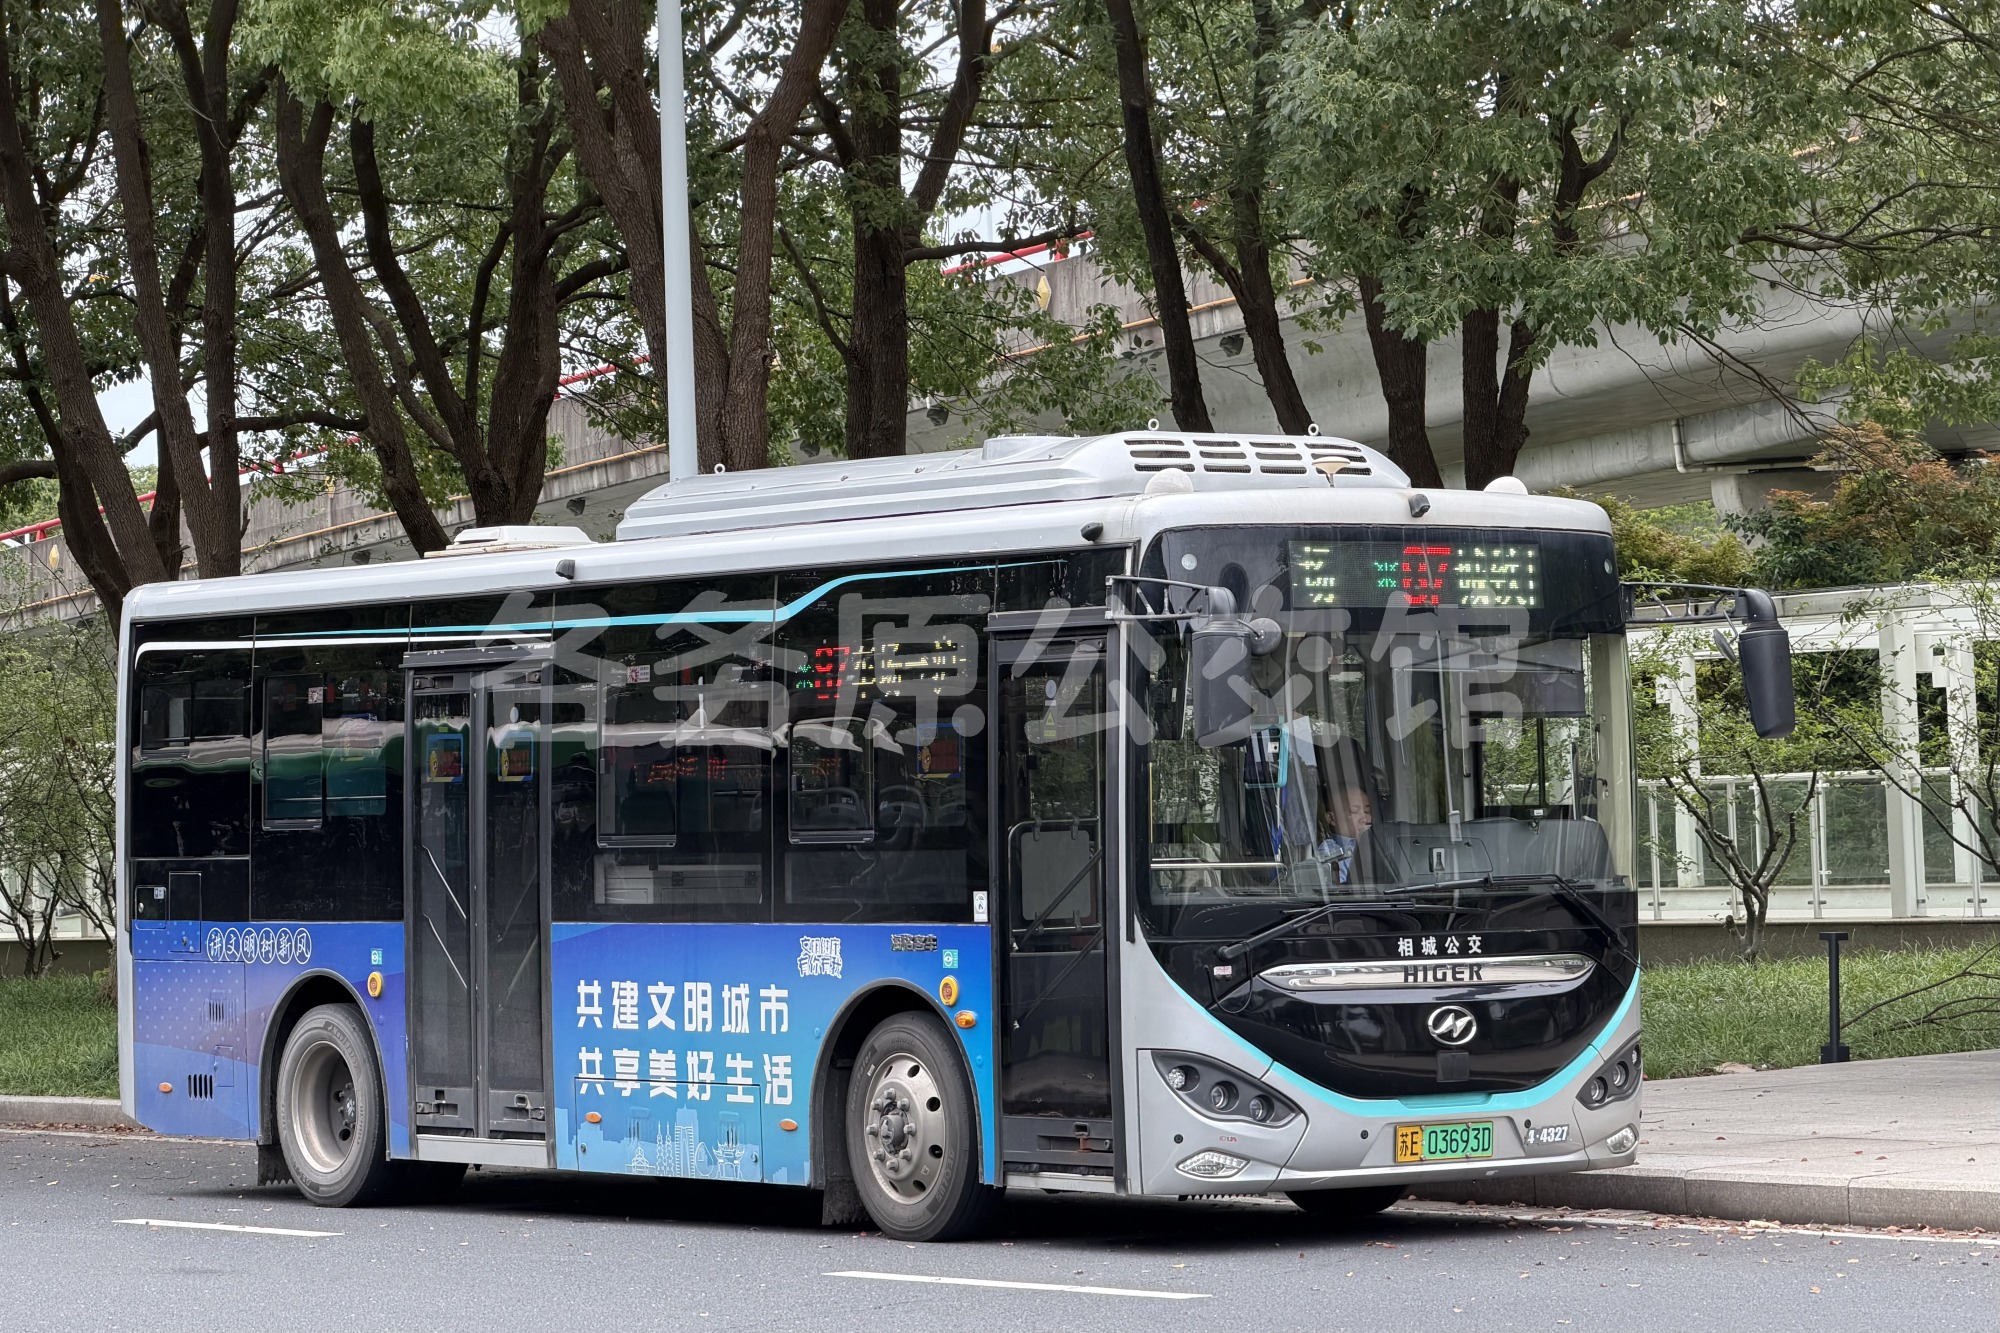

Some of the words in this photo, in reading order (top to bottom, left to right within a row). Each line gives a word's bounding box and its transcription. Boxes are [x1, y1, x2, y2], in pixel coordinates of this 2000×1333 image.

[208, 929, 312, 962] 讲文明树新风
[1397, 935, 1482, 957] 相城公交
[1403, 963, 1483, 983] HIGER
[576, 980, 789, 1035] 共建文明城市
[577, 1047, 794, 1106] 共享美好生活
